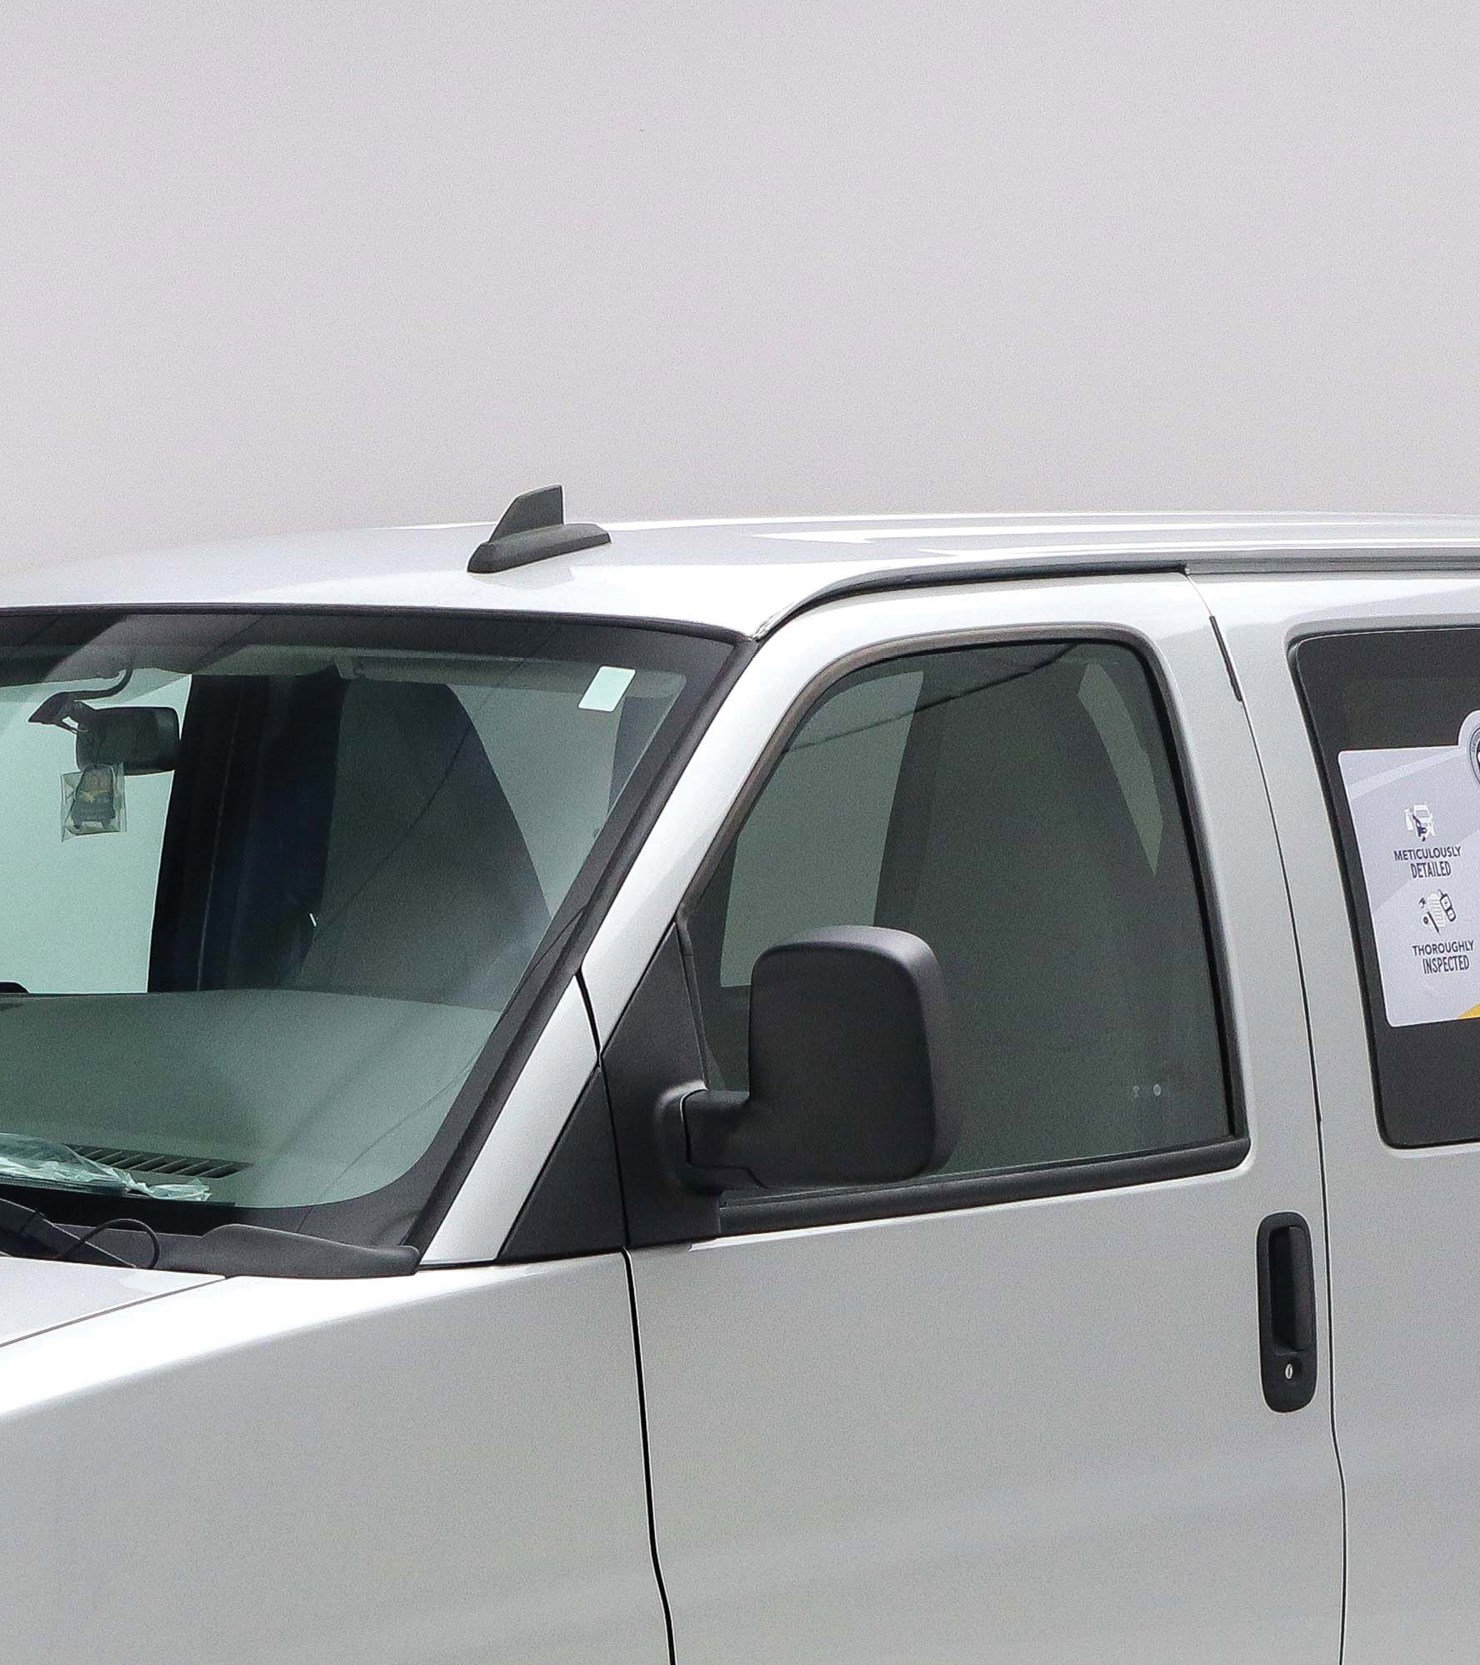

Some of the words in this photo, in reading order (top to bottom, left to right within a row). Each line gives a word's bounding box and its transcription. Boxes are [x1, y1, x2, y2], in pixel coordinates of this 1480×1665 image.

[1393, 846, 1462, 861] METICULOUSLY
[1410, 861, 1452, 878] DETAILED
[1412, 940, 1475, 956] THOROUGHLY
[1422, 955, 1470, 974] INSPECTED
